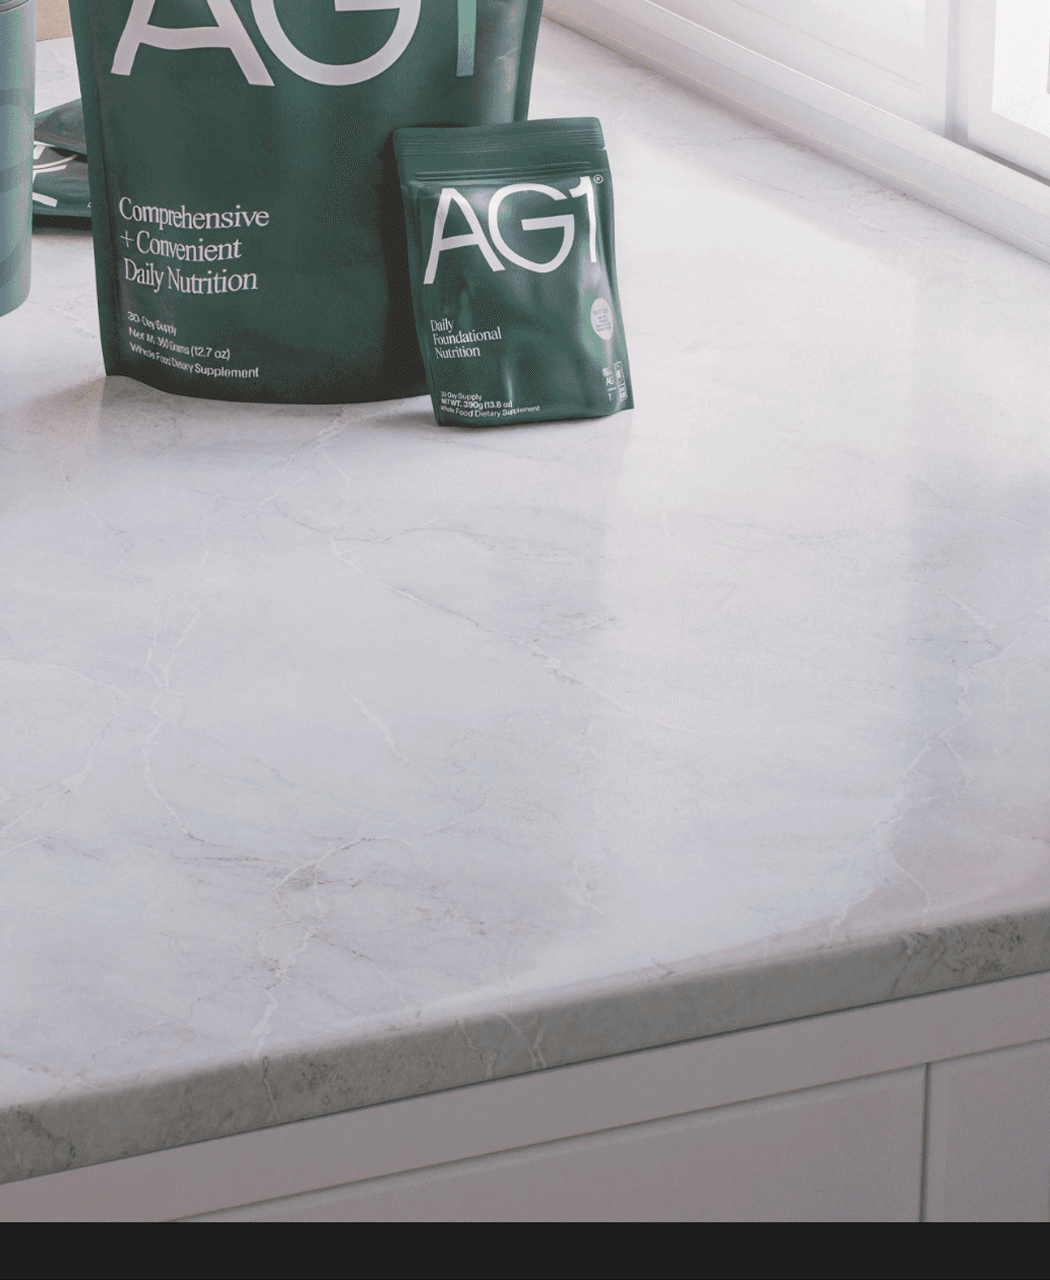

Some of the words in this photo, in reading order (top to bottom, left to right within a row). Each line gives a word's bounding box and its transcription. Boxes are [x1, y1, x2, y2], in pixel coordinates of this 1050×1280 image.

[118, 196, 270, 231] Comprehensive
[136, 230, 242, 262] Convenient
[123, 257, 164, 293] Daily
[167, 266, 258, 294] Nutrition
[430, 317, 454, 332] Daily
[433, 326, 502, 345] Foundational
[214, 348, 231, 361] oz)
[435, 344, 481, 359] Nutrition
[194, 363, 259, 379] Supplement
[455, 407, 473, 417] Food
